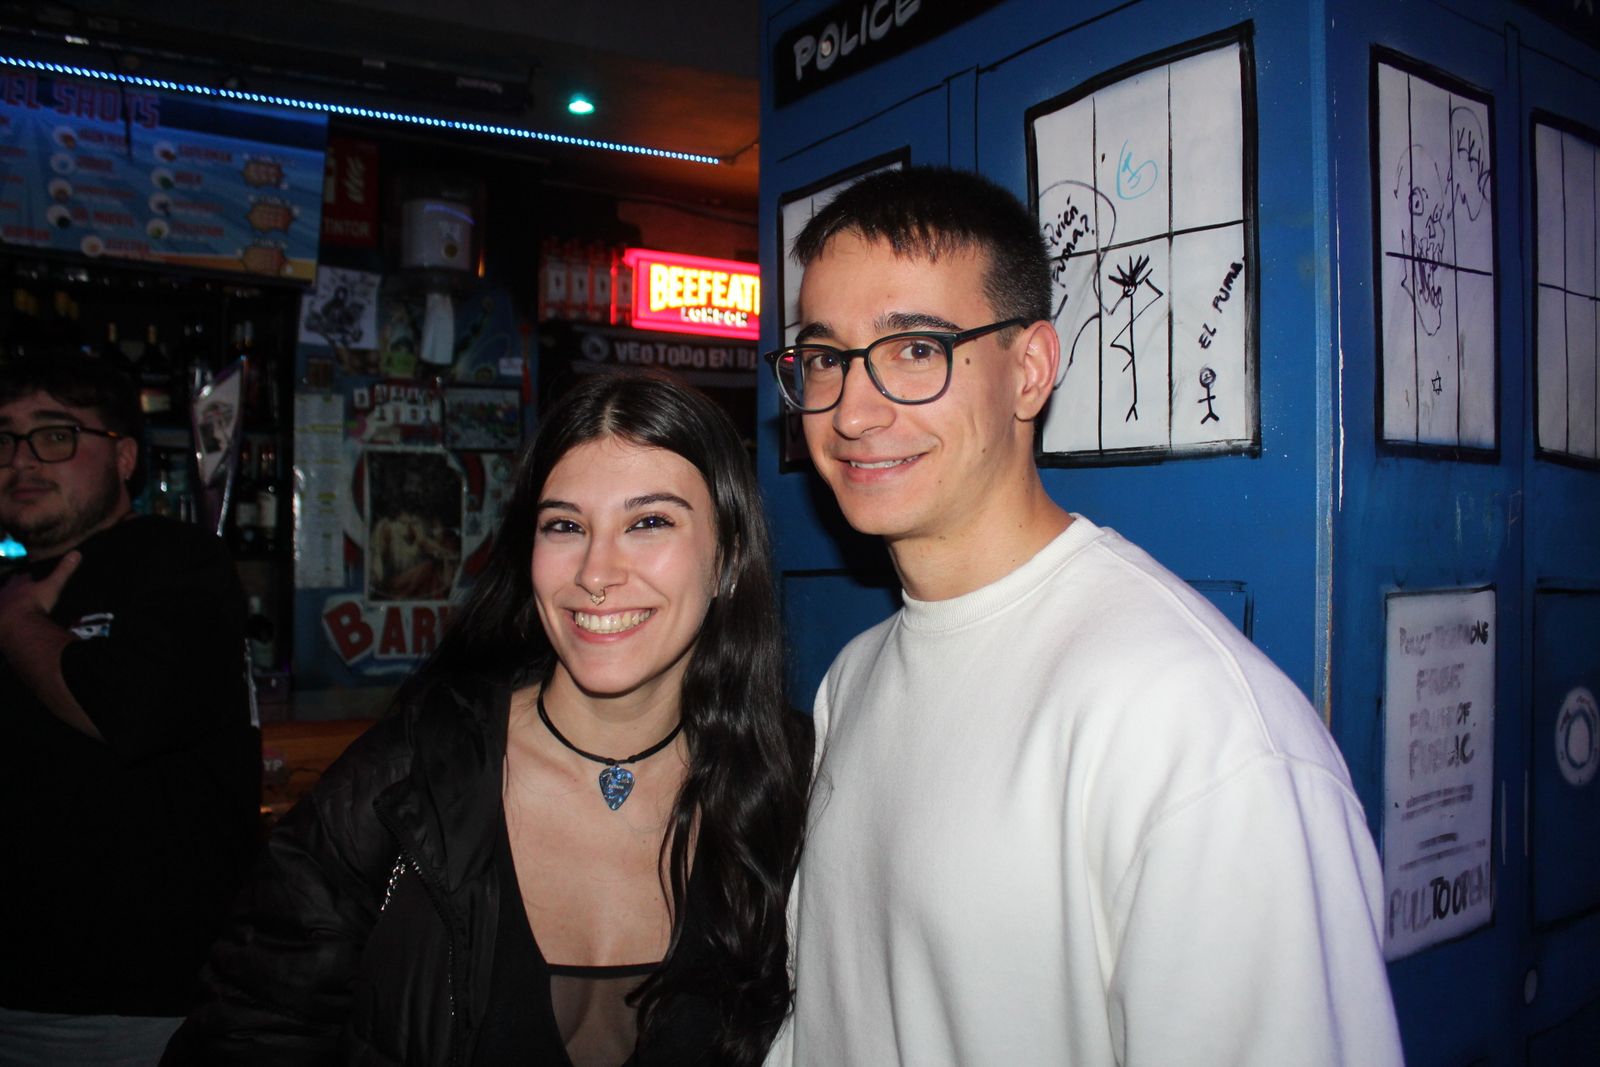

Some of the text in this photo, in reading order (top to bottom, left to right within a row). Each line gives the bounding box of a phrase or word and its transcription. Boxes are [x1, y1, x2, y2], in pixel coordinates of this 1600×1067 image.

[792, 0, 921, 81] POLICE
[54, 81, 161, 128] SHOTS
[1430, 876, 1452, 920] TO
